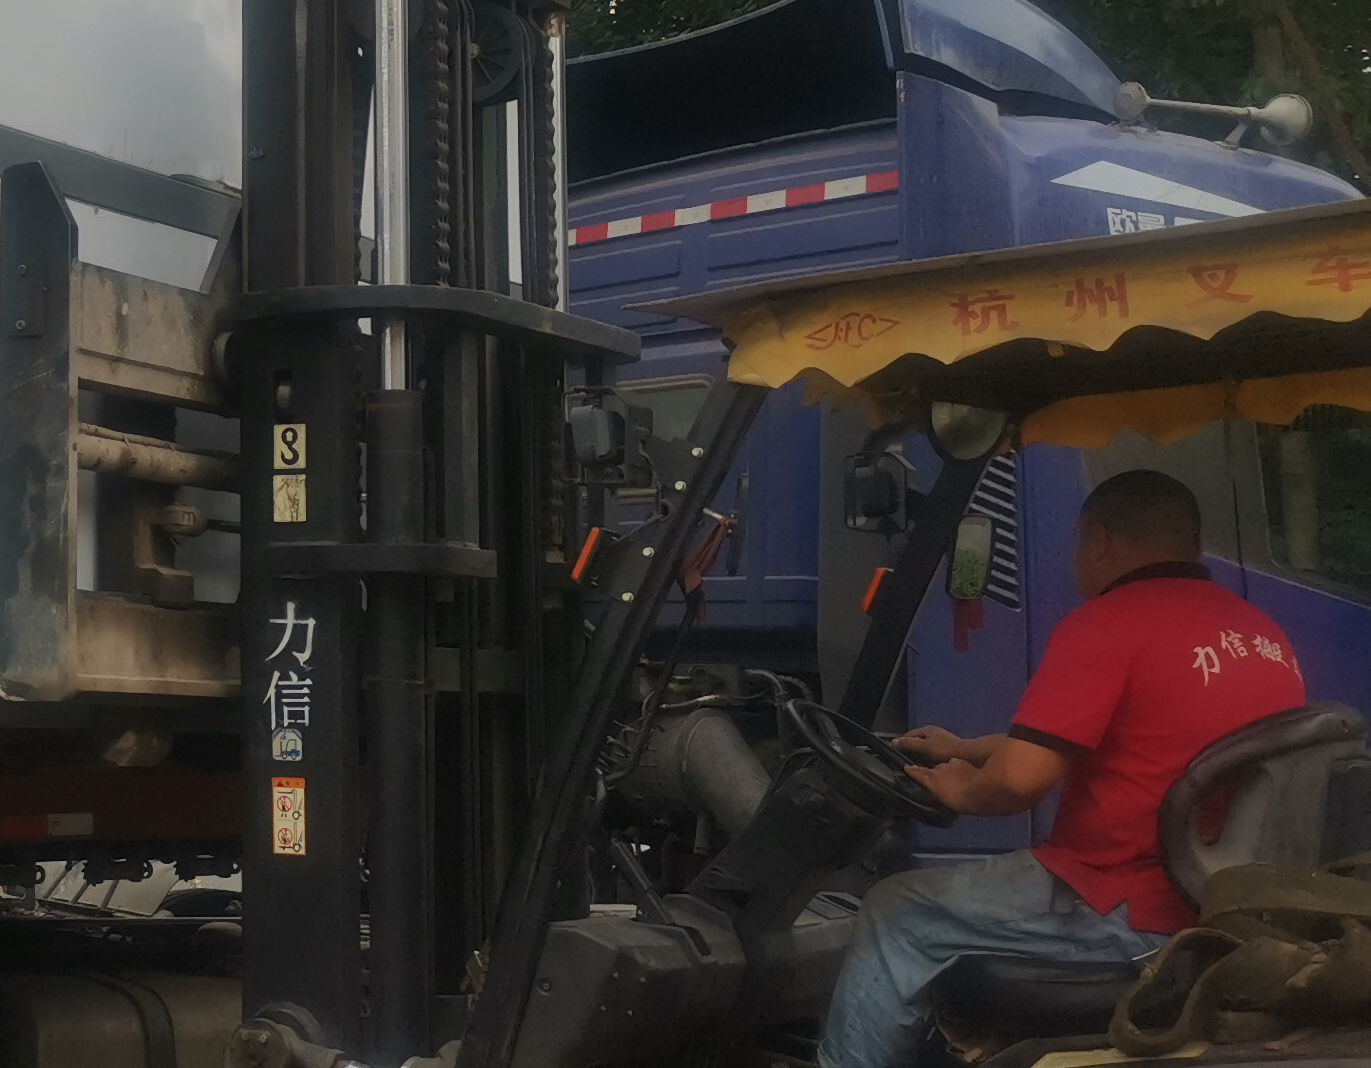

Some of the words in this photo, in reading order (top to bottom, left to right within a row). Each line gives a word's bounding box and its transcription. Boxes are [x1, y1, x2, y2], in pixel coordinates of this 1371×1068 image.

[951, 253, 1371, 337] 杭州叉车
[262, 601, 316, 731] 力信
